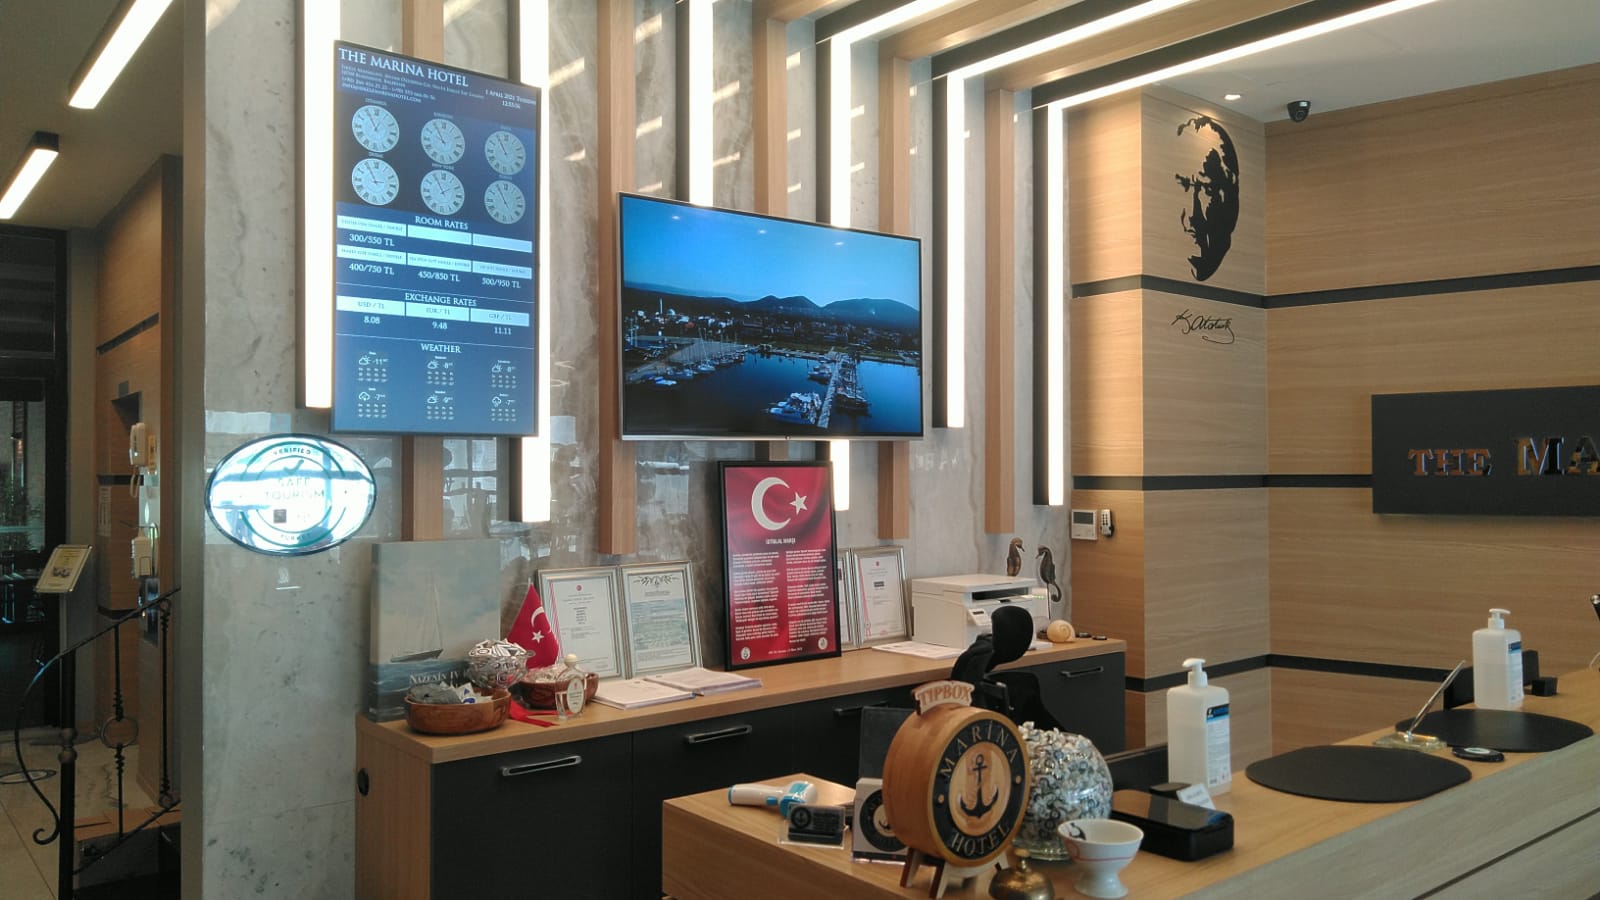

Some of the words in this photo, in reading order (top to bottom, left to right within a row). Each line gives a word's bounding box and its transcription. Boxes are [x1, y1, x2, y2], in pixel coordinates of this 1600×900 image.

[338, 48, 367, 65] THE
[370, 55, 424, 77] MARINA
[428, 68, 469, 87] HOTEL
[415, 215, 443, 227] ROOM
[444, 218, 469, 230] RATES
[349, 233, 382, 245] 300/550
[384, 237, 395, 247] TL
[349, 263, 382, 273] 400/750
[384, 266, 395, 275] TL
[450, 273, 460, 282] TL
[512, 280, 521, 289] TL
[405, 292, 451, 305] EXCHANGE
[453, 297, 477, 307] RATES
[363, 316, 380, 324] 8.08
[432, 321, 448, 330] 9.48
[494, 326, 511, 335] 11.11
[421, 343, 461, 354] WEATHER
[272, 447, 312, 456] VERIFIED
[1408, 448, 1493, 476] THE
[918, 684, 972, 706] TIPBOX
[939, 720, 1018, 779] MARINA
[951, 822, 1010, 857] HOTEL
